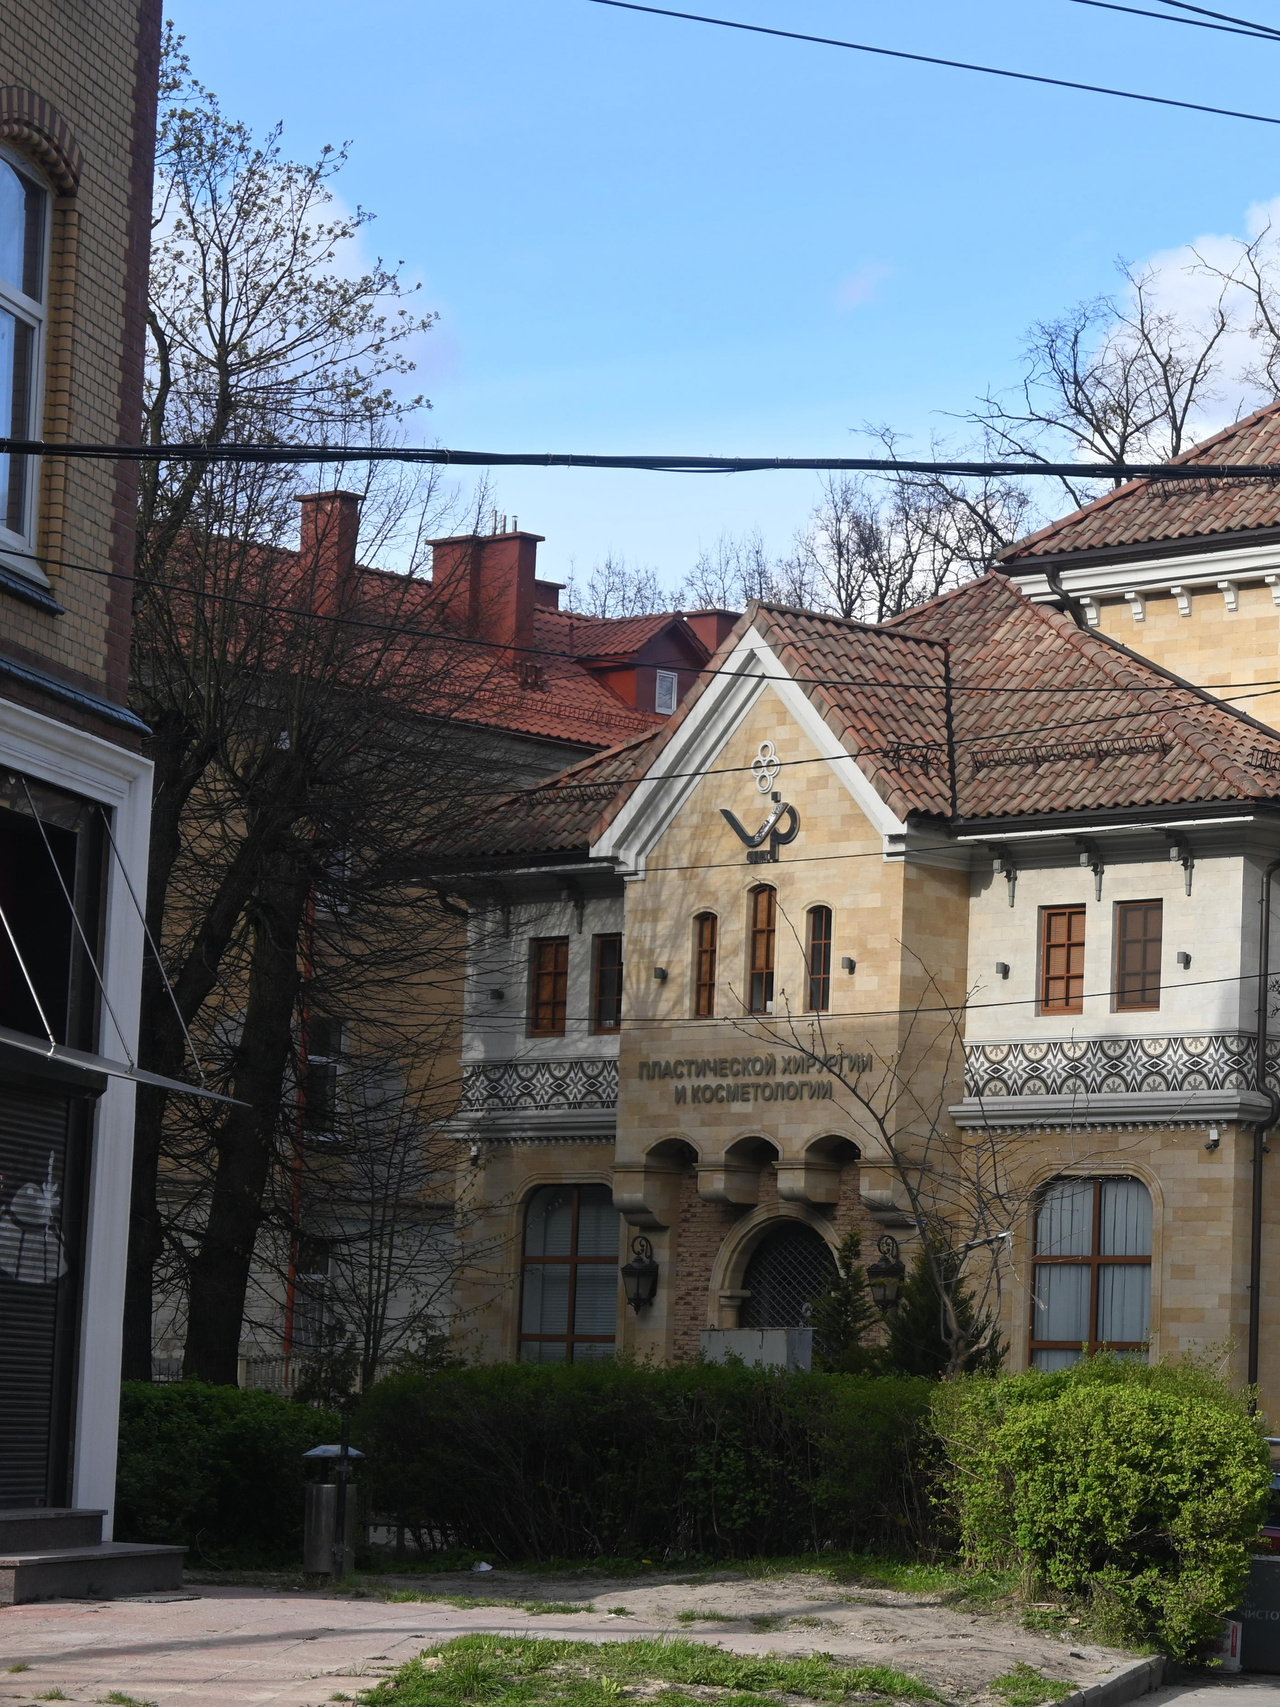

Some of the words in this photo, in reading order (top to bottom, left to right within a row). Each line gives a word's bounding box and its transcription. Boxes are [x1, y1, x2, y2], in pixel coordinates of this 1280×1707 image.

[638, 1052, 776, 1080] ПЛАСТИЧЕСКОЙ
[781, 1052, 873, 1076] ХИРУРГИИ
[674, 1085, 687, 1105] И
[691, 1080, 833, 1104] КОСМЕТОЛОГИИ
